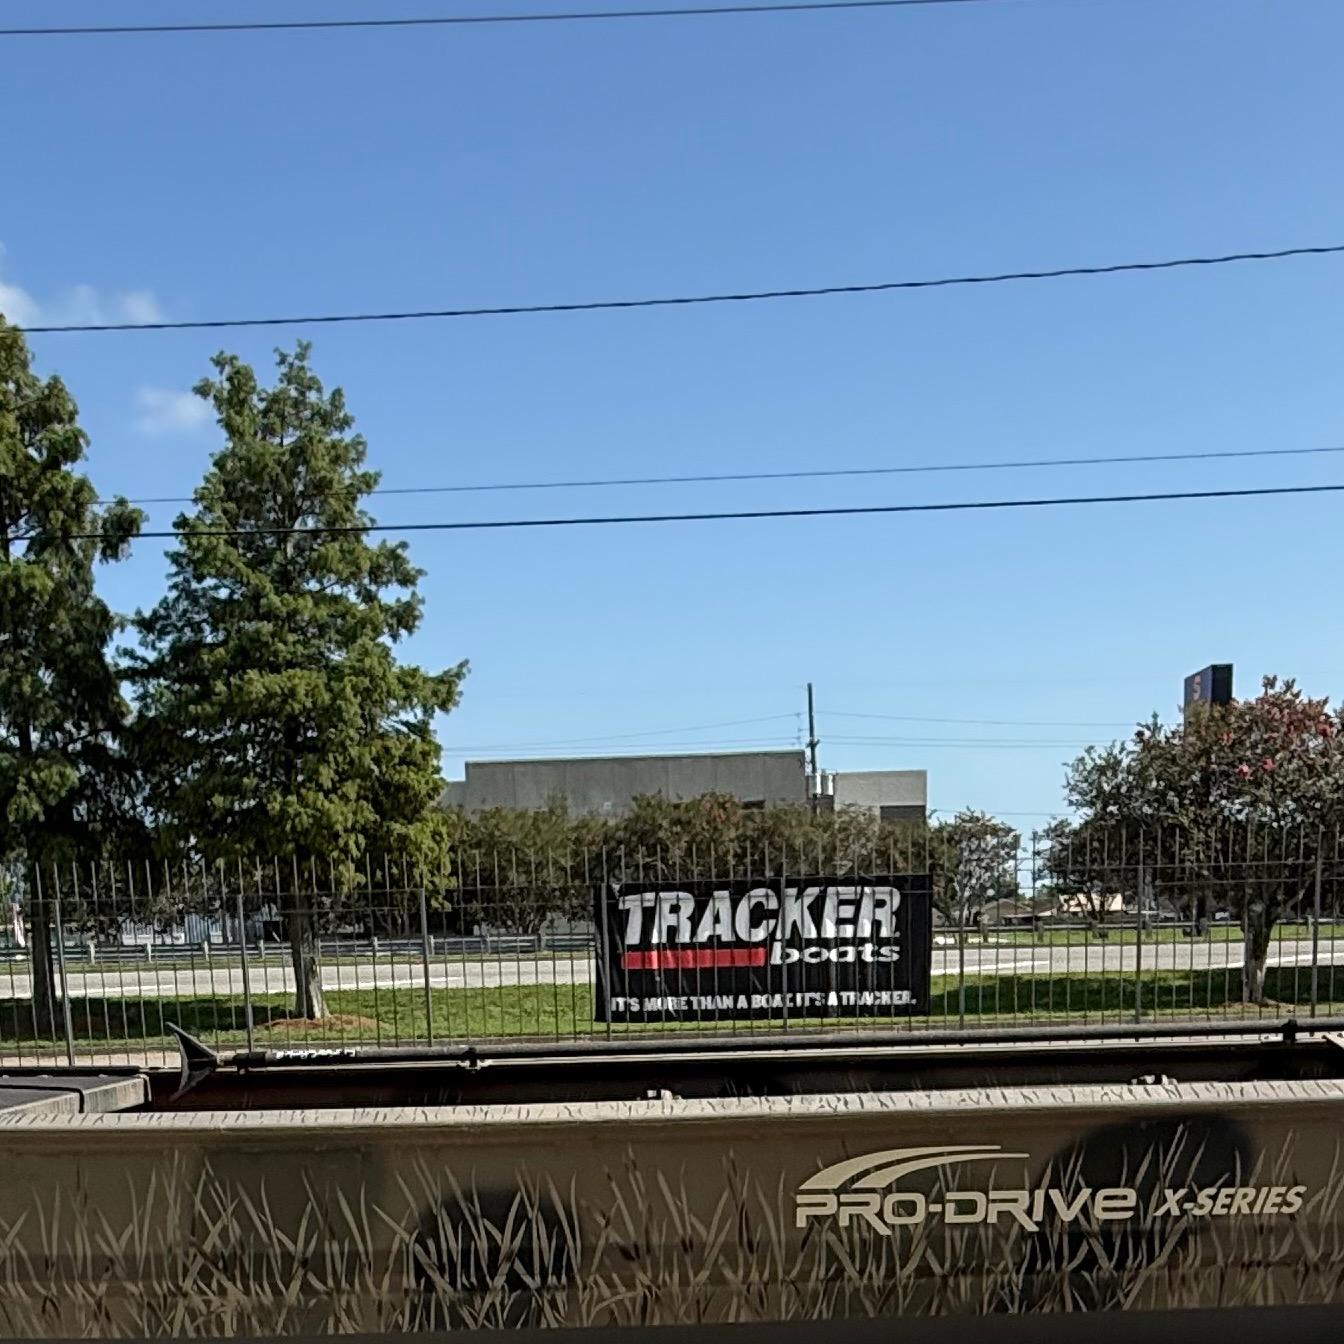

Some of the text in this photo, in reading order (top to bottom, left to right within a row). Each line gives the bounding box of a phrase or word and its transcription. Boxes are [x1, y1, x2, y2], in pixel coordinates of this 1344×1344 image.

[618, 886, 901, 945] TRACKER
[769, 941, 901, 966] boats
[610, 997, 641, 1012] IT'S
[642, 996, 688, 1012] MORE
[689, 994, 735, 1010] THAN
[736, 994, 748, 1010] A
[827, 991, 839, 1007] A
[1153, 1186, 1307, 1217] X-SERIES
